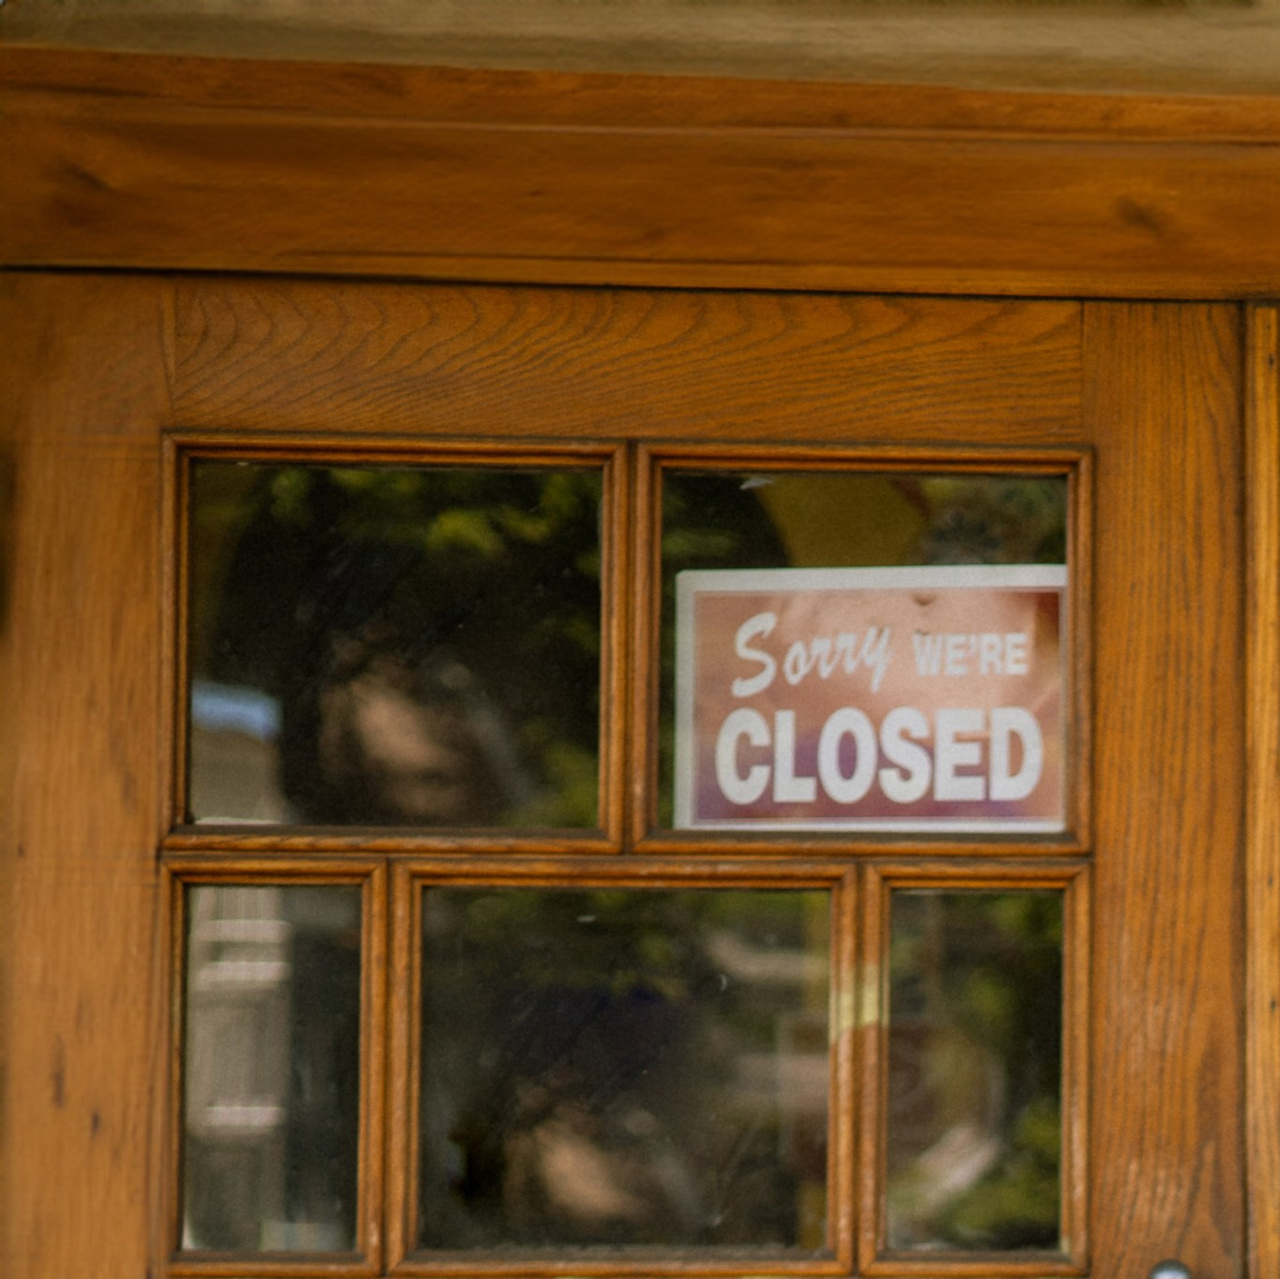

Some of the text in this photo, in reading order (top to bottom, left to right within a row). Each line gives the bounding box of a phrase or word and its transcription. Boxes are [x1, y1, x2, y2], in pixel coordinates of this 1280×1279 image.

[732, 612, 1029, 697] Sorry WE'RE
[715, 707, 1043, 804] CLOSED
